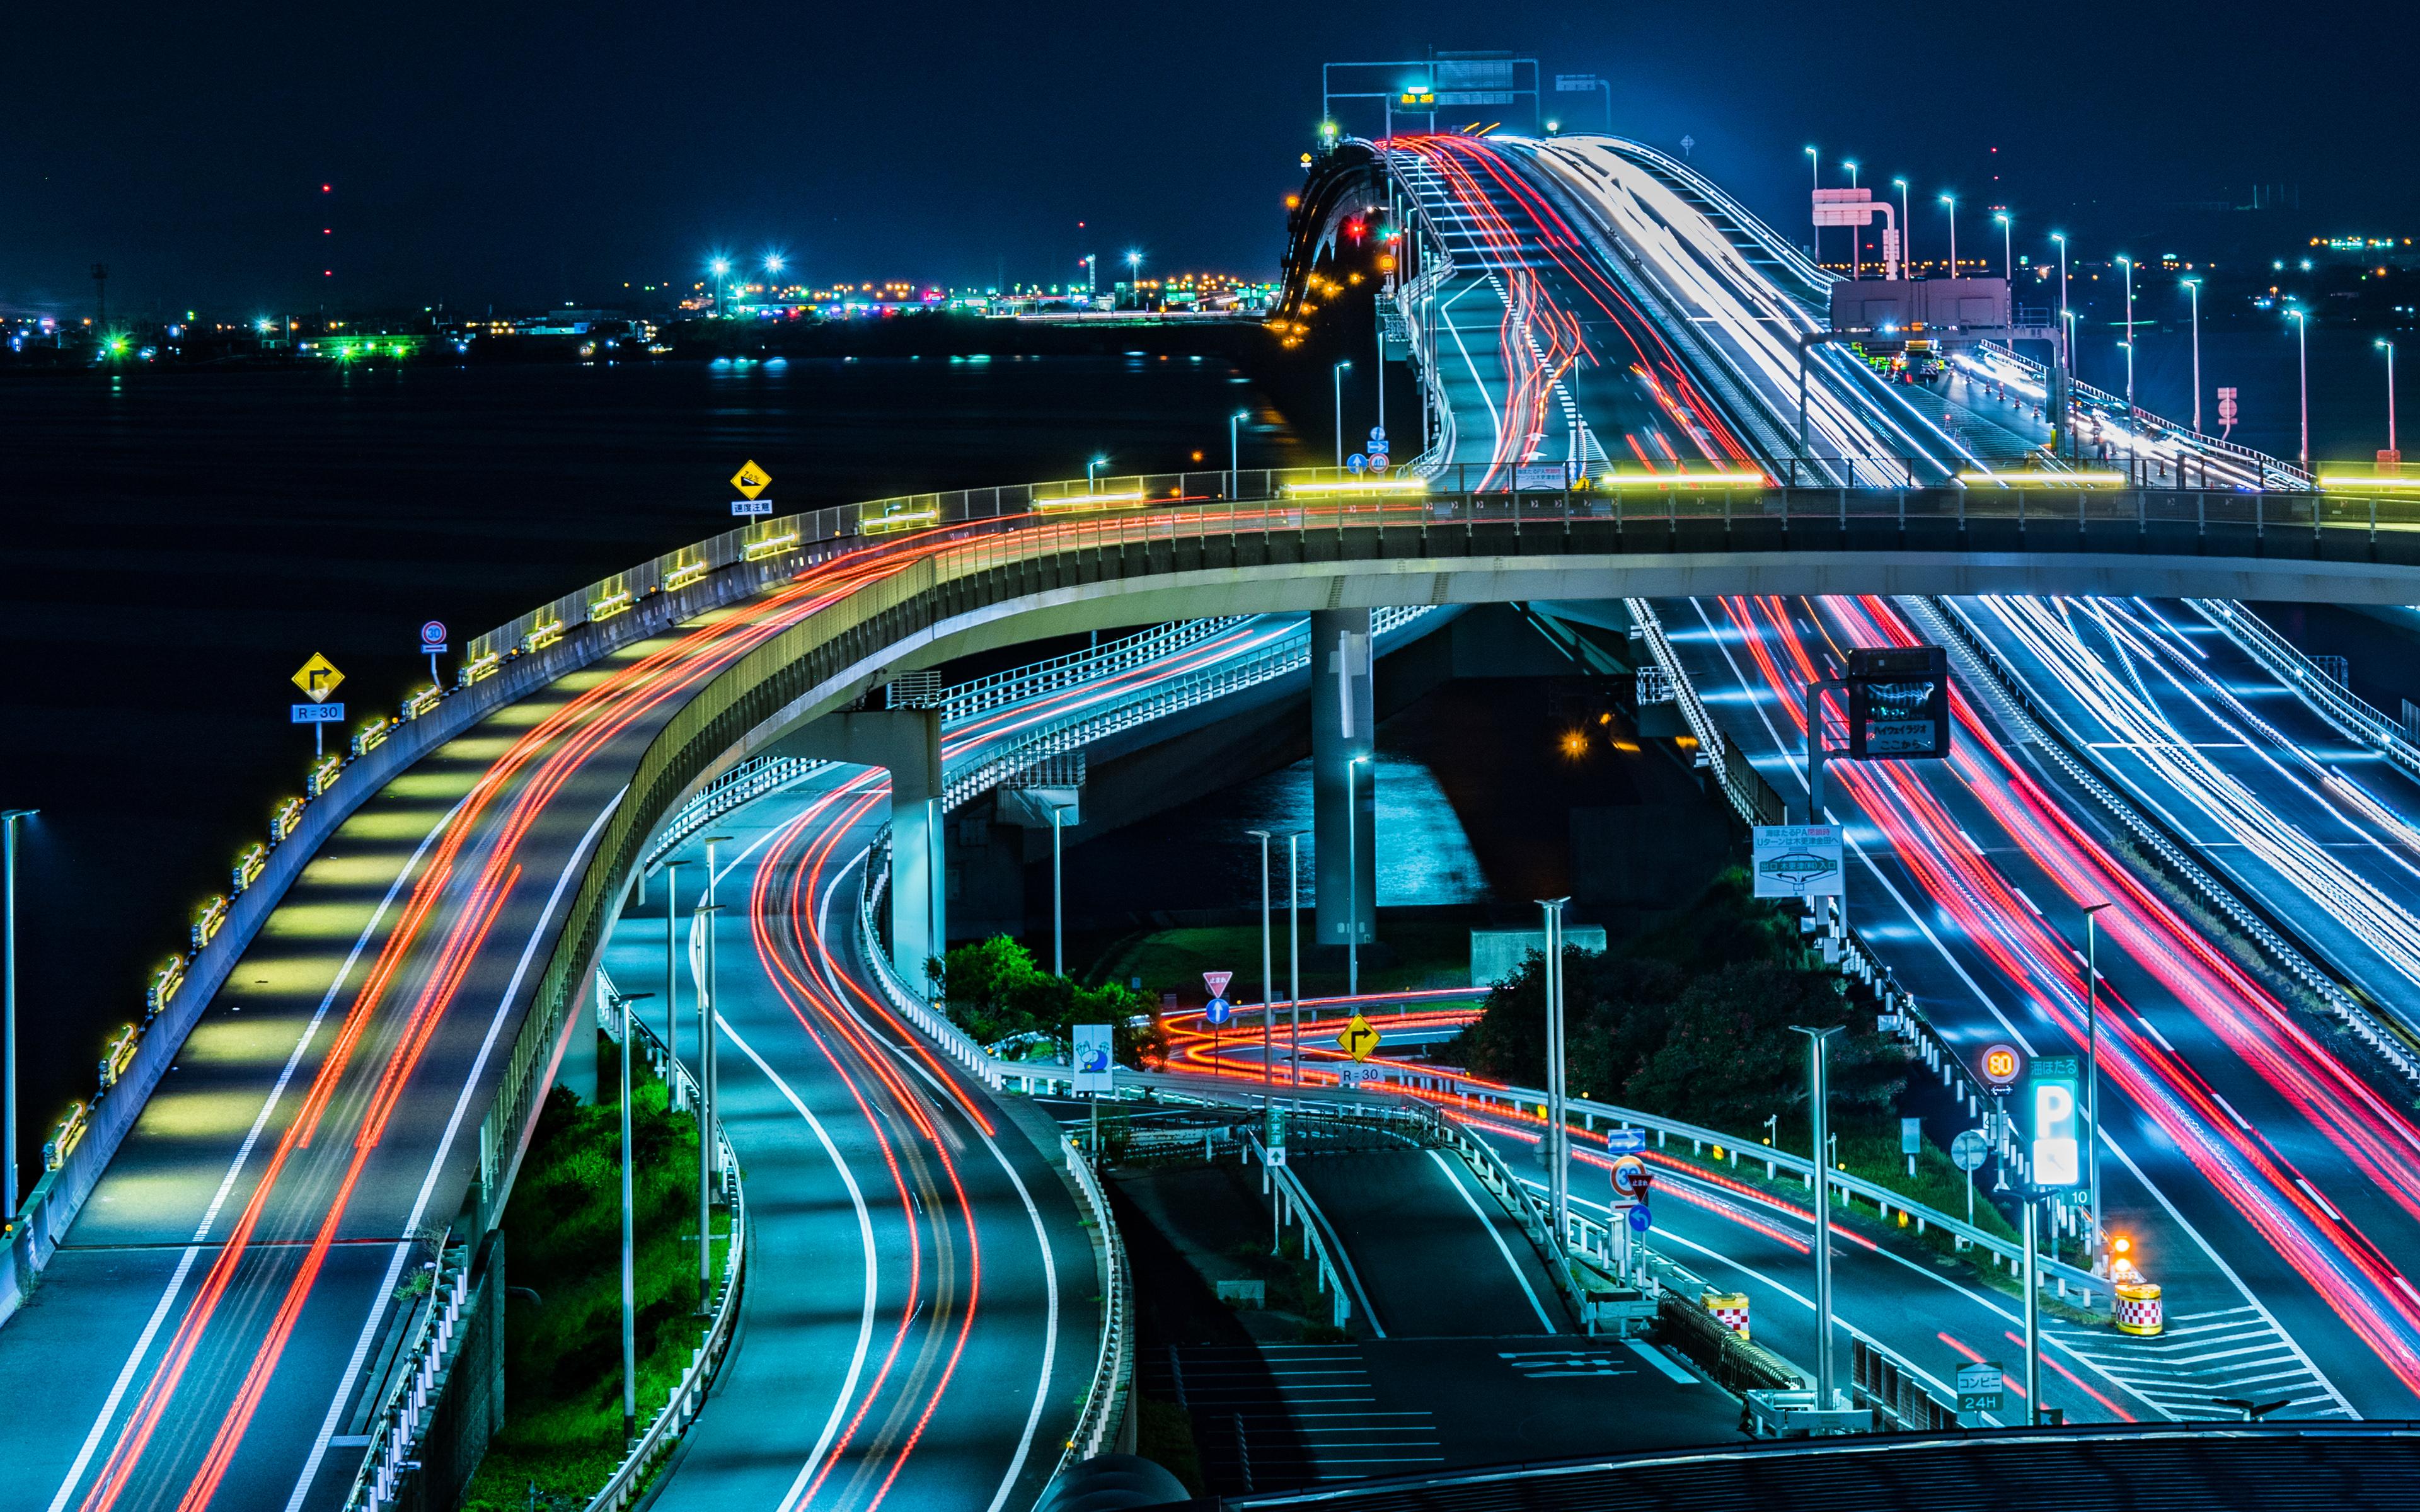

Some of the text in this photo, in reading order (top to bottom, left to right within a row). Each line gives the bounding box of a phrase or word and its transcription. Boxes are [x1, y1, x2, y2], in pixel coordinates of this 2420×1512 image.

[1374, 459, 1385, 467] 40
[734, 503, 770, 513] 速度注意
[427, 627, 441, 639] 30
[1880, 739, 1921, 750] ここから
[1761, 862, 1778, 871] 出口
[1819, 861, 1836, 869] 入口
[2031, 1059, 2077, 1075] 海ほたる
[2037, 1085, 2073, 1139] P
[1270, 1112, 1281, 1145] 木更津
[2072, 1191, 2088, 1204] 10
[1960, 1377, 2000, 1389] コンビニ
[1965, 1396, 1996, 1409] 24H
